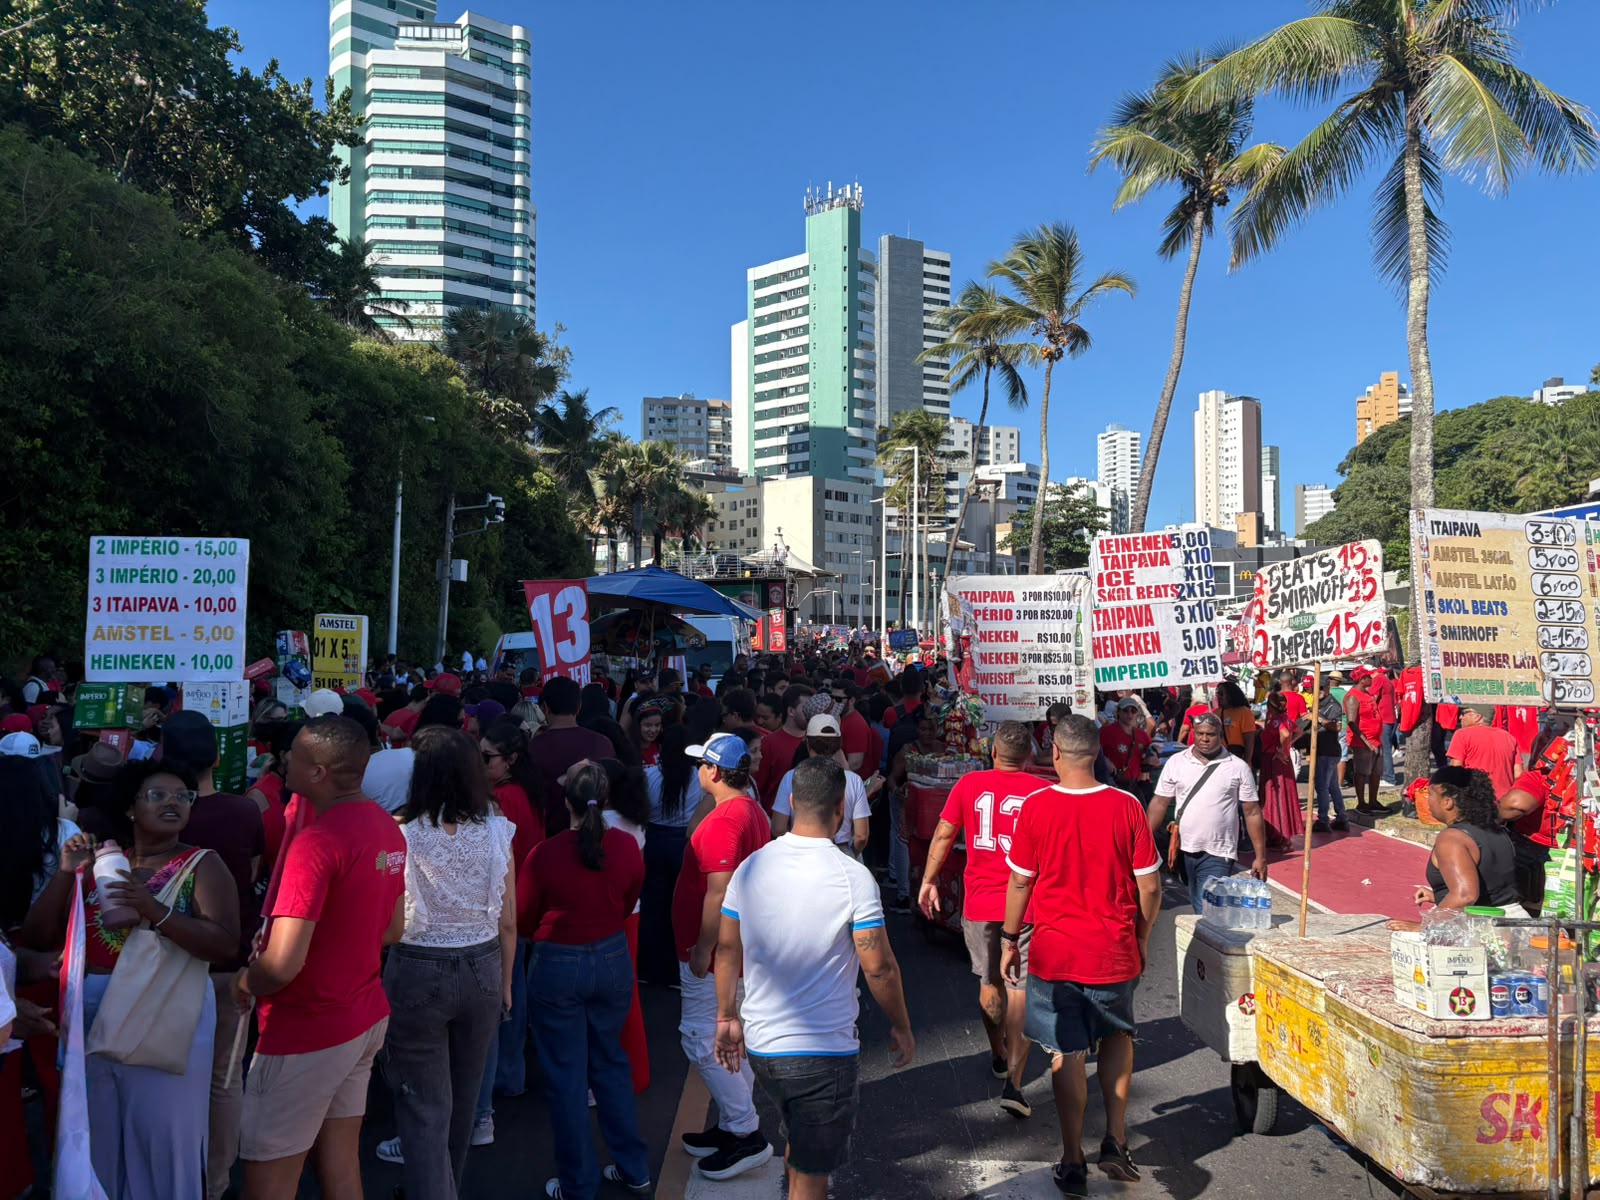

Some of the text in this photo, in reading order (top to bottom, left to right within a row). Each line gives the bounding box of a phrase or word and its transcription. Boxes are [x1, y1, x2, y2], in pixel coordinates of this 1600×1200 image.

[1431, 520, 1482, 538] ITAIPAVA
[96, 539, 105, 555] 2
[111, 538, 179, 555] IMPÉRIO
[195, 541, 237, 559] 15,00
[1172, 531, 1208, 549] 5,00
[1433, 546, 1479, 563] AMSTEL
[96, 568, 105, 583] 3
[110, 565, 178, 584] IMPÉRIO
[192, 569, 236, 587] 20,00
[1097, 570, 1136, 588] ICE
[1436, 572, 1482, 589] AMSTEL
[1483, 574, 1517, 591] LATÃO
[1022, 592, 1027, 602] 3
[1029, 591, 1042, 601] POR
[1097, 587, 1133, 602] SKOL
[1136, 584, 1180, 600] BEATS
[1268, 574, 1350, 619] SMIRNOFF
[93, 597, 102, 612] 3
[107, 597, 179, 612] ITAIPAVA
[194, 597, 236, 616] 10,00
[974, 606, 1073, 621] PÉRIO 3 POR R$20,00
[1174, 605, 1185, 624] 3
[1438, 598, 1469, 614] SKOL
[1471, 600, 1508, 616] BEATS
[320, 618, 355, 629] AMSTEL
[531, 585, 590, 668] 13
[92, 625, 175, 641] AMSTEL
[193, 625, 235, 644] 5,00
[979, 630, 1018, 643] NEKEN
[1440, 625, 1498, 642] SMIRNOFF
[314, 637, 326, 658] 01
[330, 638, 338, 659] X
[1092, 631, 1162, 659] HEINEKEN
[1182, 627, 1216, 652] 5,00
[91, 654, 175, 670] HEINEKEN
[191, 654, 233, 673] 10,00
[980, 652, 1018, 665] NEKEN
[1022, 653, 1027, 663] 3
[1028, 653, 1042, 663] POR
[1443, 651, 1511, 669] BUDWEISER
[976, 673, 1015, 685] WEISER
[1095, 661, 1169, 683] IMPERIO
[1445, 678, 1505, 695] HEINEKEN
[981, 693, 1009, 706] STEL
[1039, 696, 1073, 707] R$500
